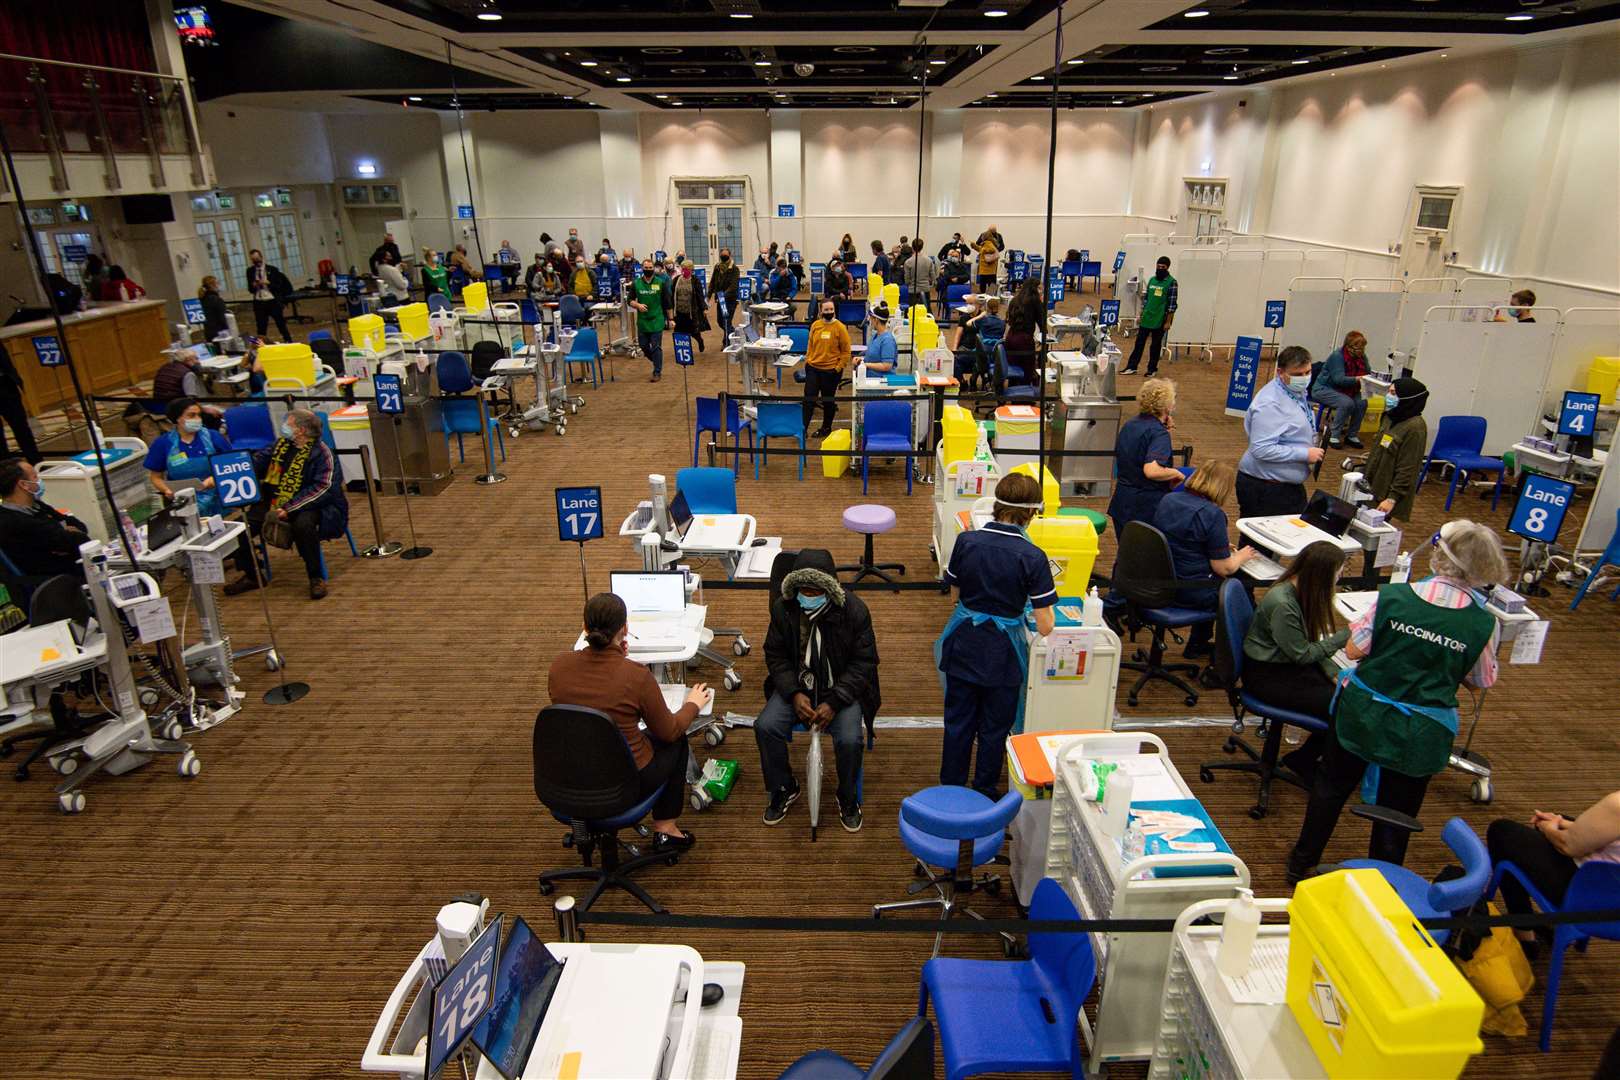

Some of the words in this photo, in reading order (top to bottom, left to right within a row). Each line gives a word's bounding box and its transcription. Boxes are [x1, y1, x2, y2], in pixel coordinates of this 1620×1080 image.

[1014, 271, 1023, 279] 12
[338, 284, 349, 294] 25
[600, 286, 612, 296] 23
[740, 289, 750, 298] 13
[1051, 290, 1062, 299] 11
[188, 310, 206, 323] 26
[1103, 312, 1116, 323] 10
[1270, 314, 1279, 325] 2
[675, 338, 690, 346] Lane
[40, 351, 60, 364] 27
[678, 349, 690, 362] 15
[1239, 354, 1253, 362] Stay
[1238, 362, 1252, 370] safe
[376, 380, 398, 390] Lane
[1234, 384, 1248, 392] Stay
[380, 393, 401, 410] 21
[1566, 400, 1595, 411] Lane
[1568, 414, 1584, 432] 4
[215, 461, 251, 476] Lane
[220, 476, 257, 503] 20
[1524, 484, 1566, 507] Lane
[562, 498, 598, 509] Lane
[565, 512, 598, 535] 17
[1525, 507, 1548, 533] 8
[1390, 619, 1468, 653] VACCINATOR
[440, 945, 494, 1018] Lane
[439, 973, 488, 1051] 18
